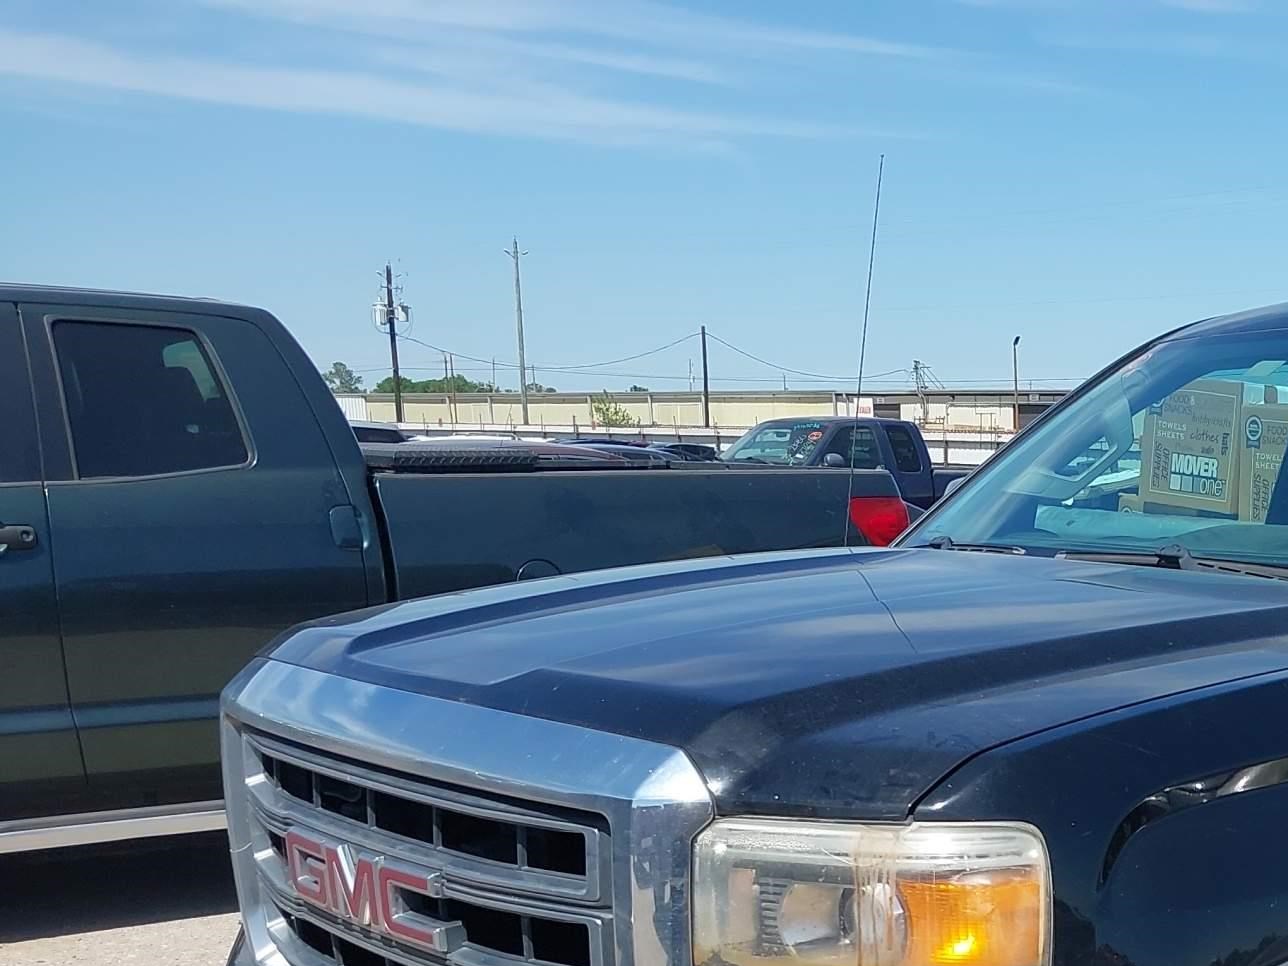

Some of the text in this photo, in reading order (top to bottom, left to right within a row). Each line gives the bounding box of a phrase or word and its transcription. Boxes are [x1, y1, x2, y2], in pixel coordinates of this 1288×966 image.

[1158, 421, 1187, 431] TOWELS
[1156, 430, 1185, 440] SHEETS
[1171, 453, 1218, 478] MOVER
[285, 827, 449, 953] GMC
